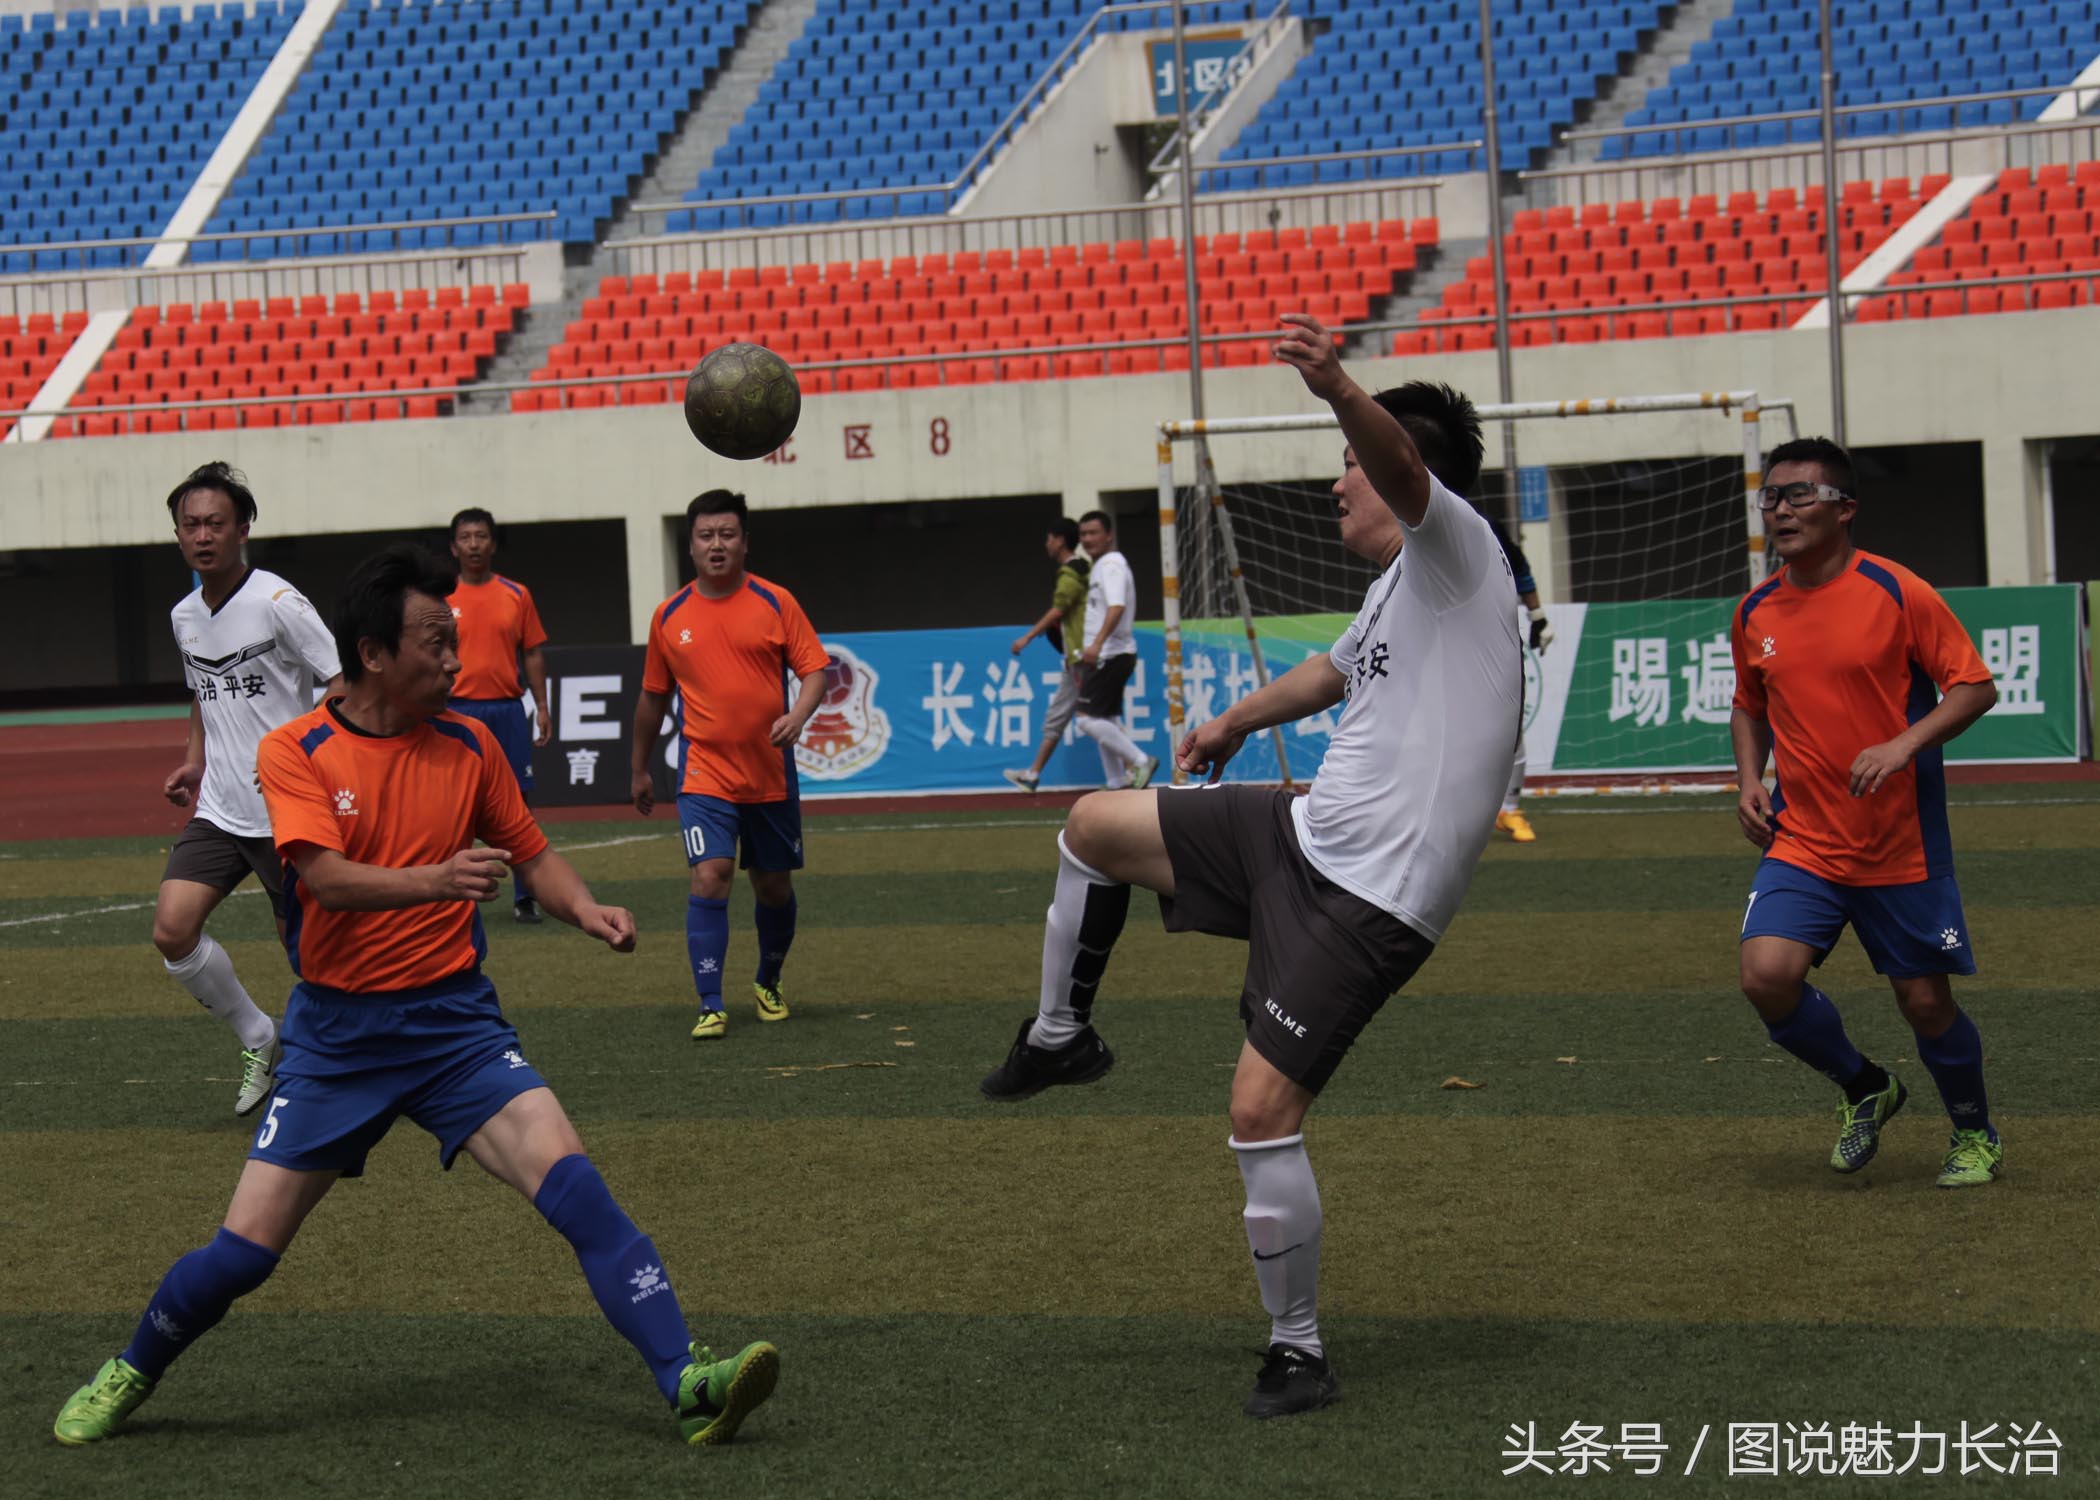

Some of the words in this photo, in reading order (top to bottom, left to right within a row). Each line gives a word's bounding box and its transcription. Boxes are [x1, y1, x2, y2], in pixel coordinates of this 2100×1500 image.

[566, 748, 600, 786] 育
[684, 826, 705, 858] 10
[1264, 997, 1308, 1038] KELME
[257, 1096, 289, 1149] 5
